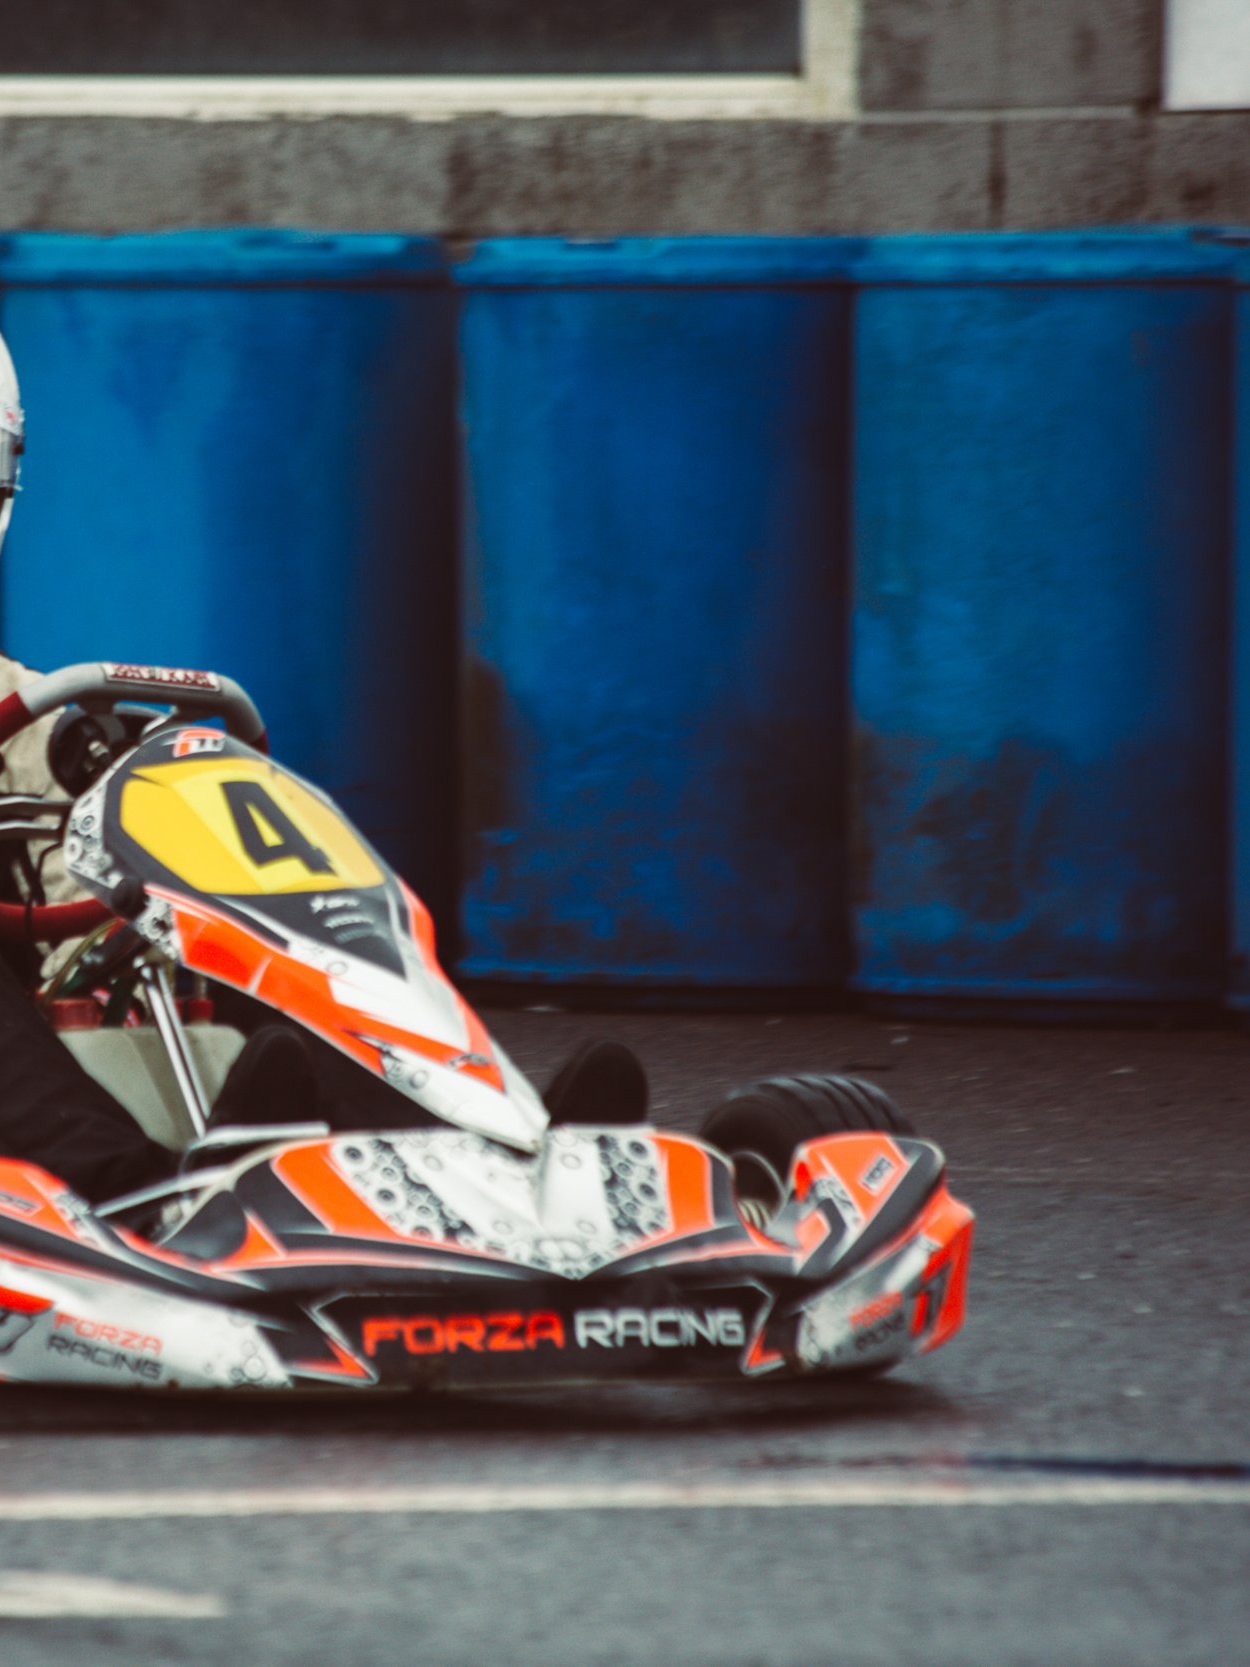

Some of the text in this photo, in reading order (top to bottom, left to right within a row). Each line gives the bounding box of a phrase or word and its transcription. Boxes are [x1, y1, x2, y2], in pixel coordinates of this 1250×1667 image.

[220, 781, 337, 875] 4
[53, 1311, 163, 1356] FORZA
[362, 1309, 743, 1356] FORZA RACING
[49, 1334, 162, 1379] RACING
